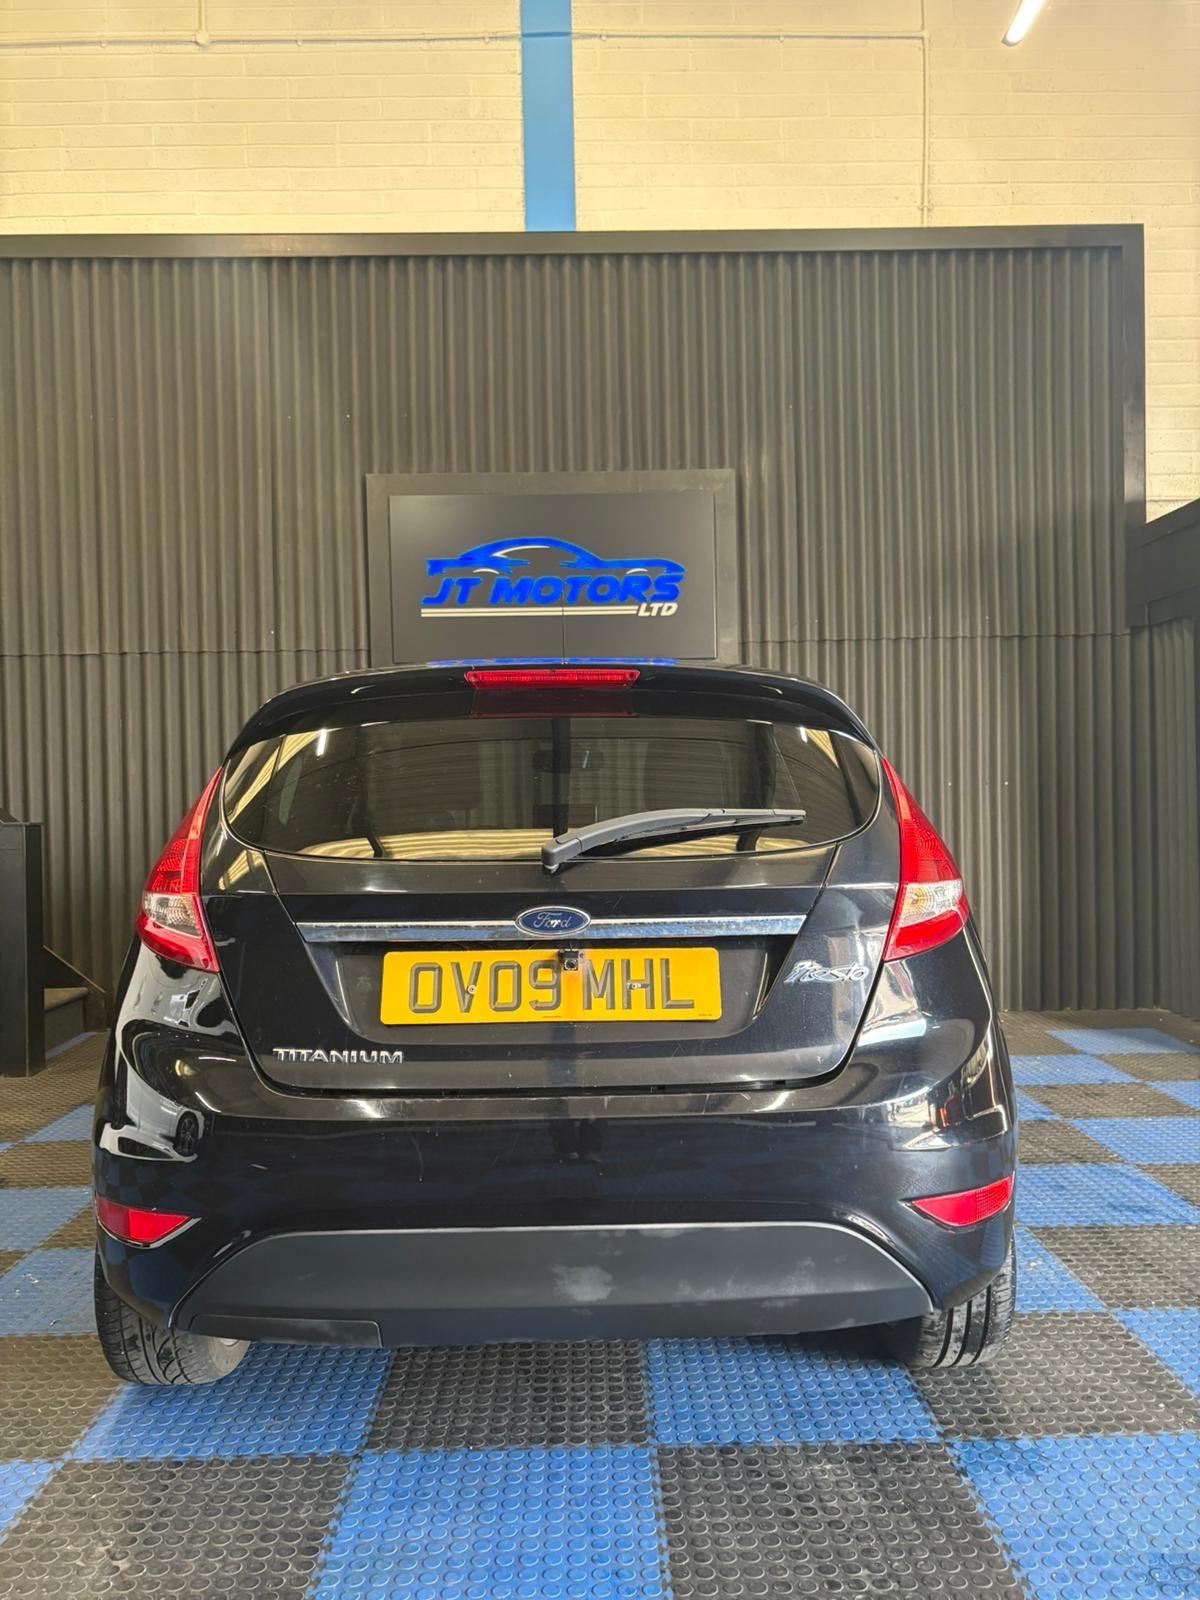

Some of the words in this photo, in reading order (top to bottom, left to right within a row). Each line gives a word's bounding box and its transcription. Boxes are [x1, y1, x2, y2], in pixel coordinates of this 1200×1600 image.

[421, 576, 482, 605] JT
[487, 574, 685, 605] MOTORS
[637, 602, 678, 617] LTD
[532, 911, 573, 929] Ford
[408, 960, 562, 1013] OV09
[582, 958, 695, 1011] MHL
[272, 1048, 404, 1064] TITANIUM
